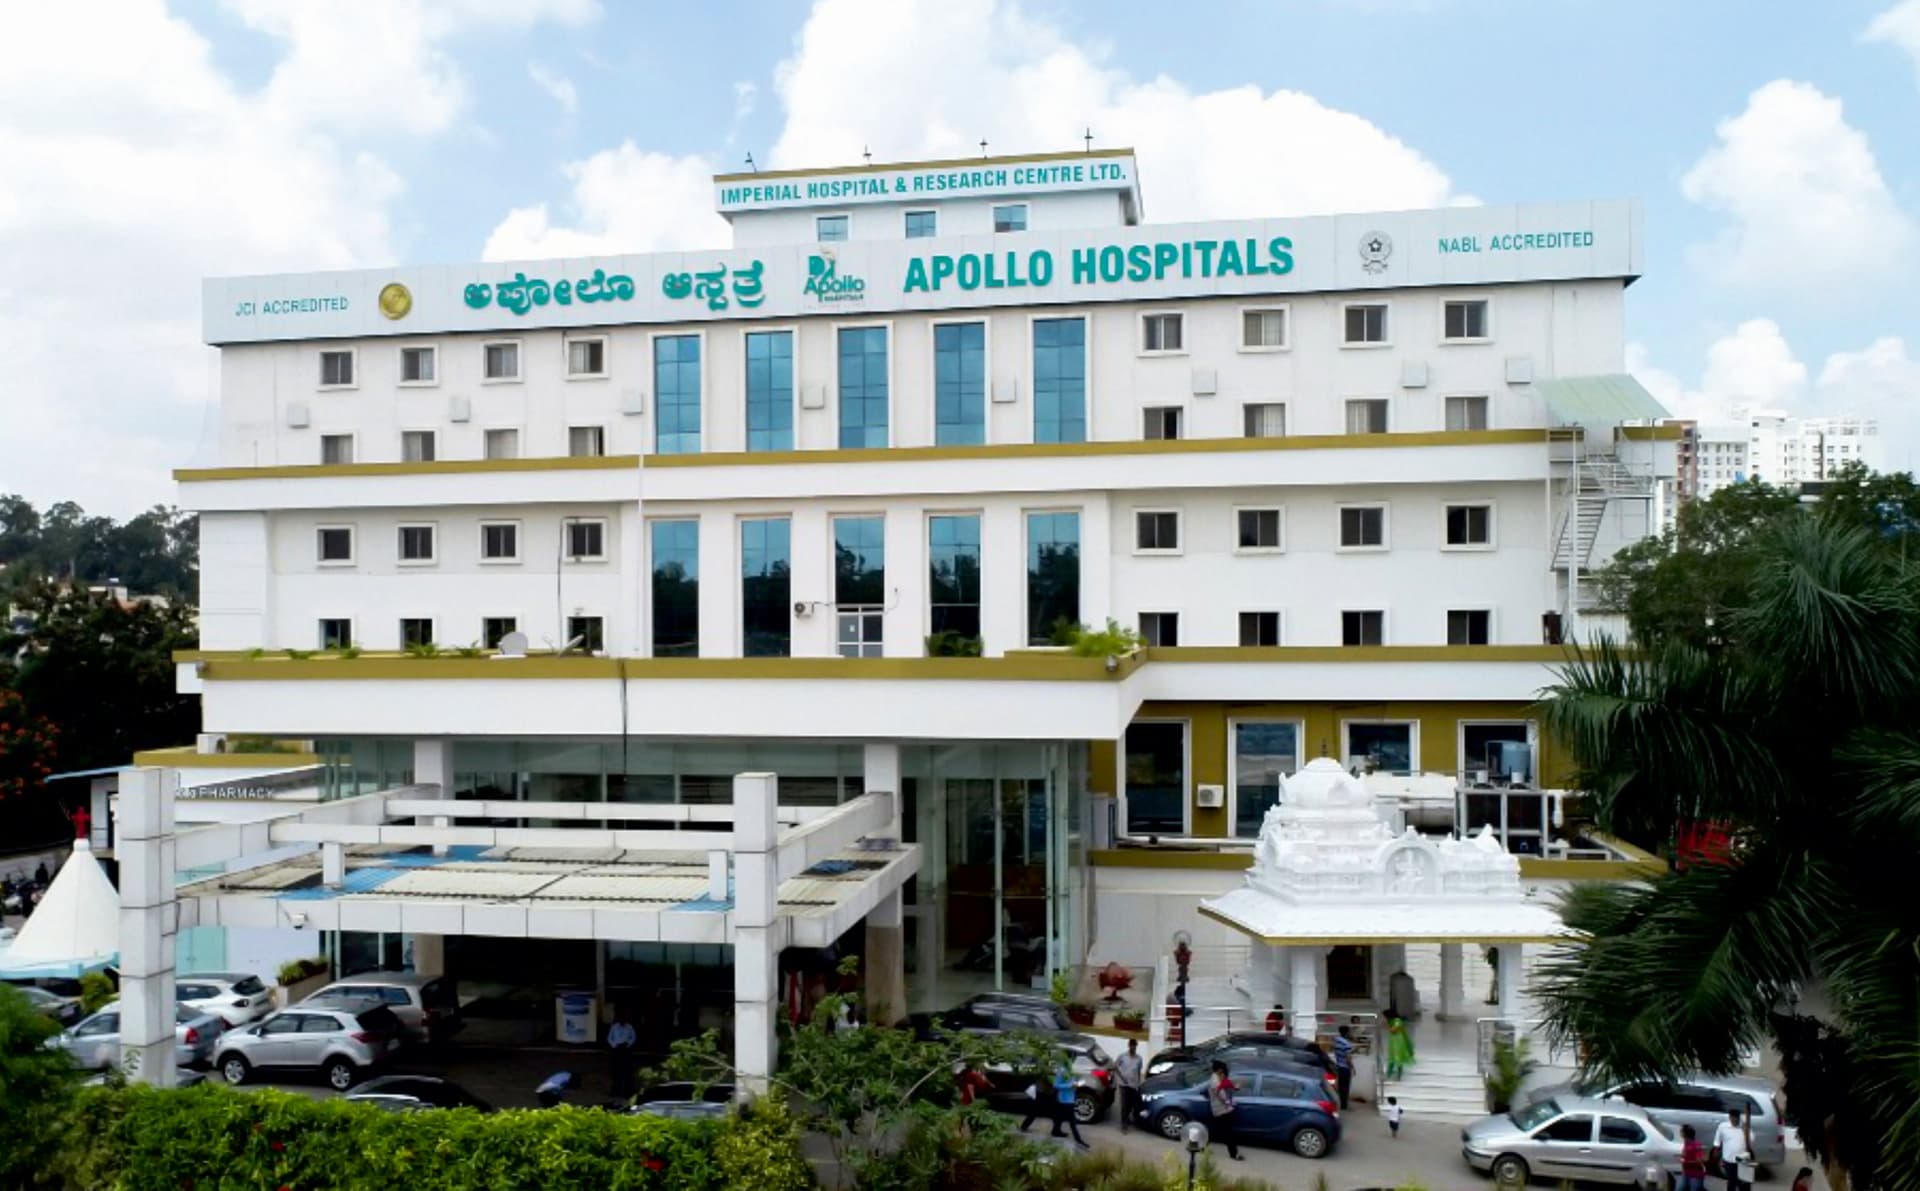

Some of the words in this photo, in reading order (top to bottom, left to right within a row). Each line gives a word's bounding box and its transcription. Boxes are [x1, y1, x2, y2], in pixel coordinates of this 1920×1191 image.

[721, 184, 801, 205] IMPERIAL
[807, 178, 888, 198] HOSPITAL
[895, 177, 906, 192] &
[913, 170, 1007, 191] RESEARCH
[1014, 166, 1084, 184] CENTRE
[1090, 163, 1126, 180] LTD.
[1438, 237, 1482, 254] NABL
[1490, 232, 1594, 251] ACCREDITED
[903, 249, 1054, 293] APOLLO
[1071, 237, 1295, 285] HOSPITALS
[803, 274, 865, 302] Apollo
[235, 302, 256, 316] JCI
[263, 297, 349, 315] ACCREDITED
[199, 786, 275, 799] PHARMACY
